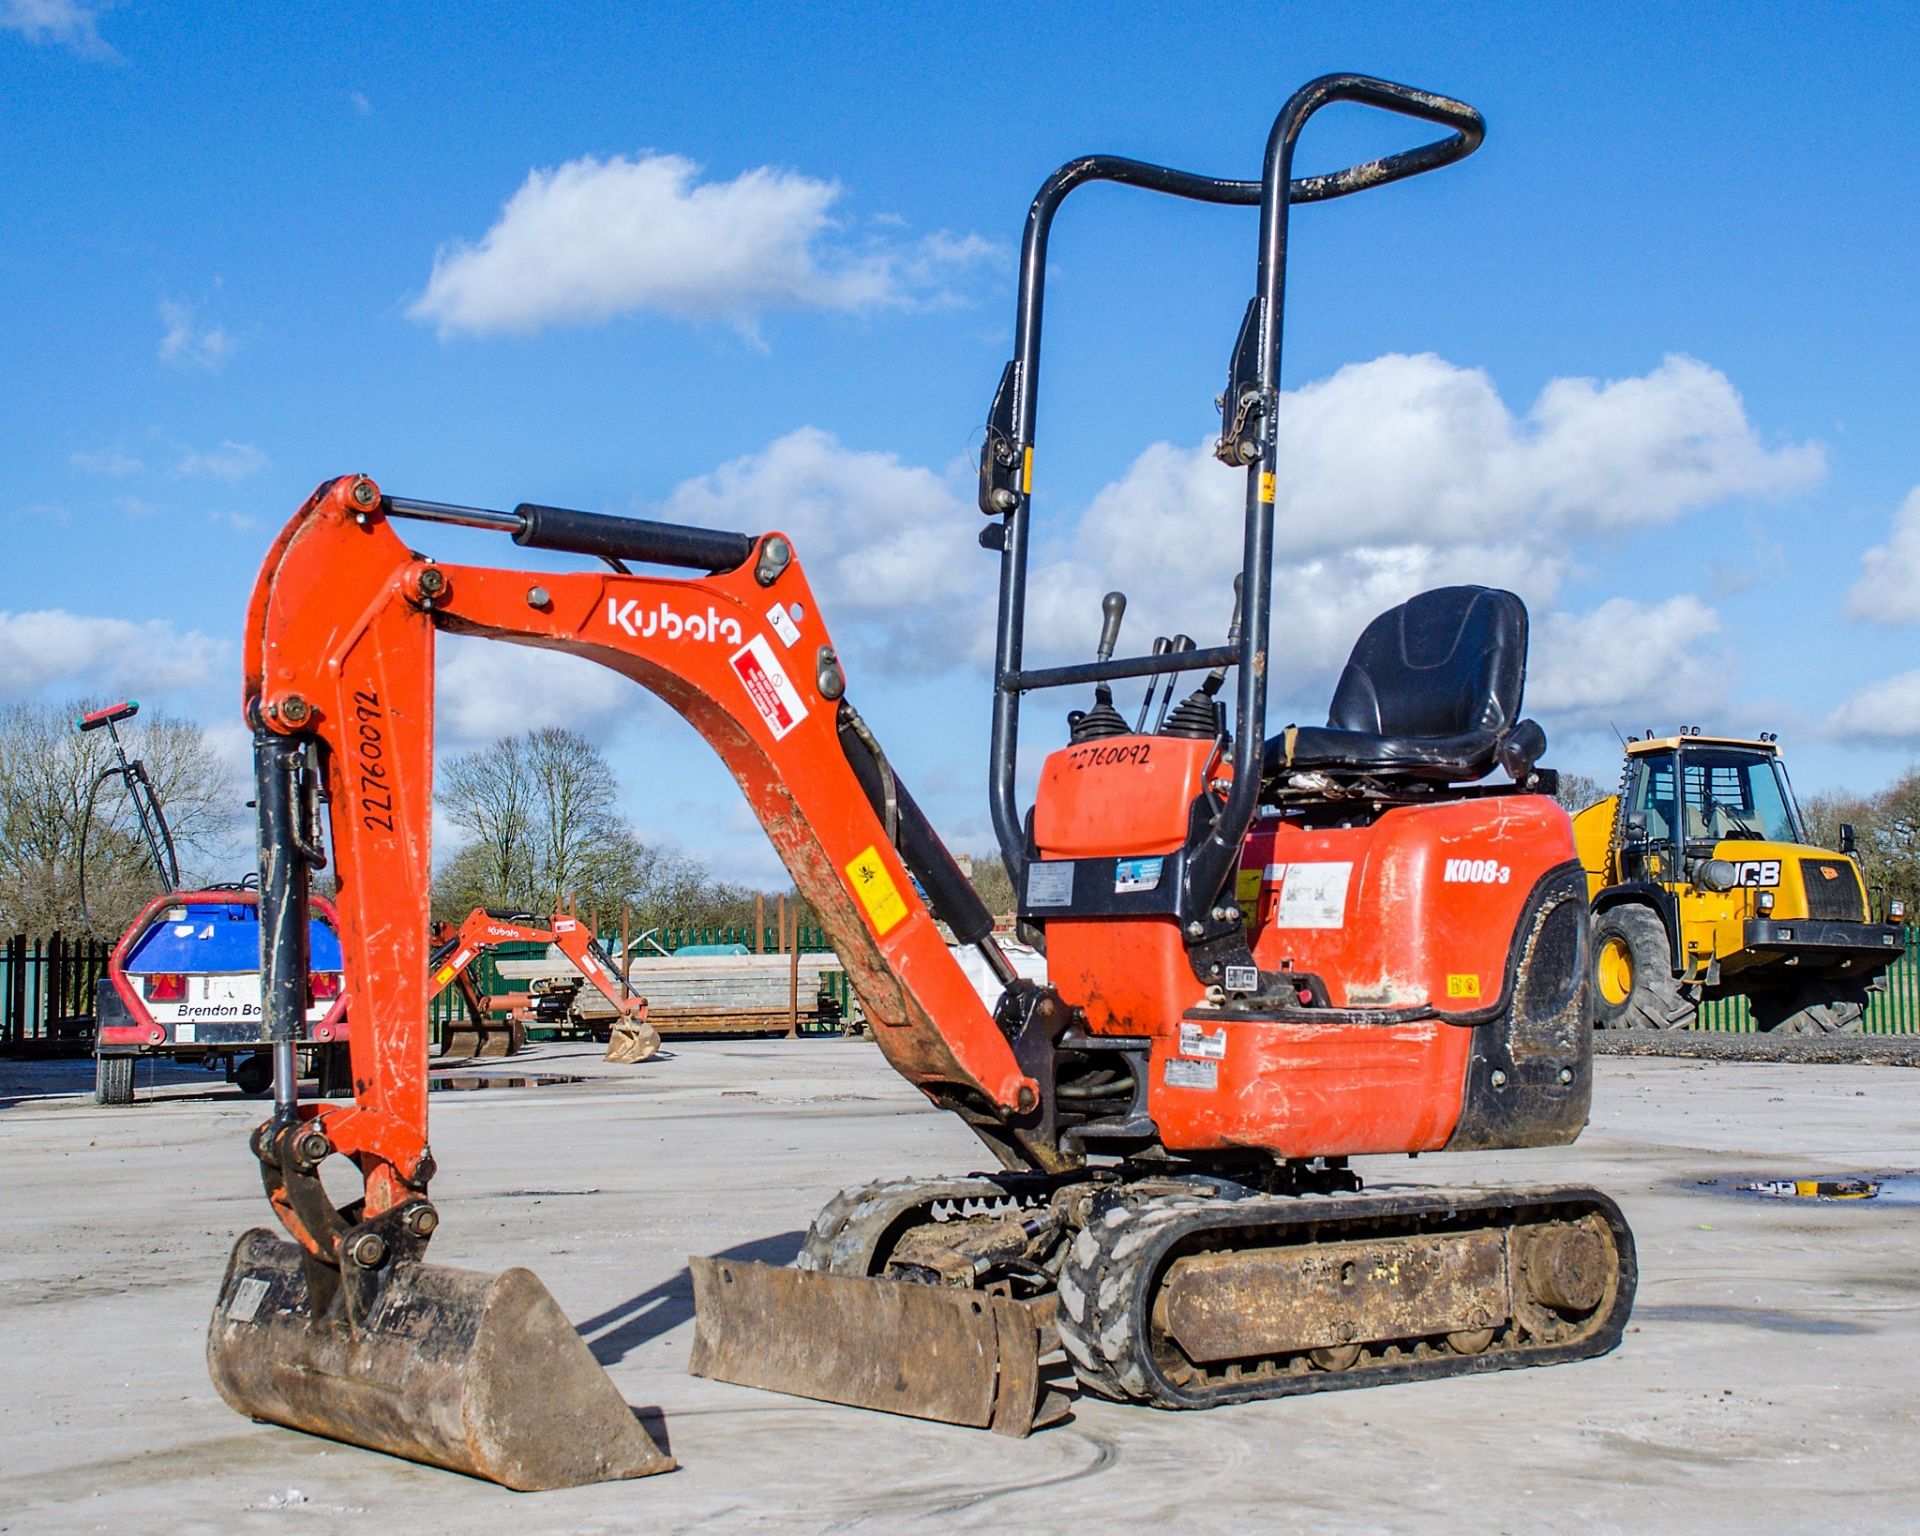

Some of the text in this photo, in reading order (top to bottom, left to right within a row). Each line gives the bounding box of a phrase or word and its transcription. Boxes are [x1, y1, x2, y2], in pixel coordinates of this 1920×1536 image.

[608, 598, 742, 645] Kubota
[353, 691, 393, 832] 22760092
[1444, 859, 1510, 883] K008-3
[487, 926, 519, 938] Kubota
[178, 1004, 237, 1016] Brendon
